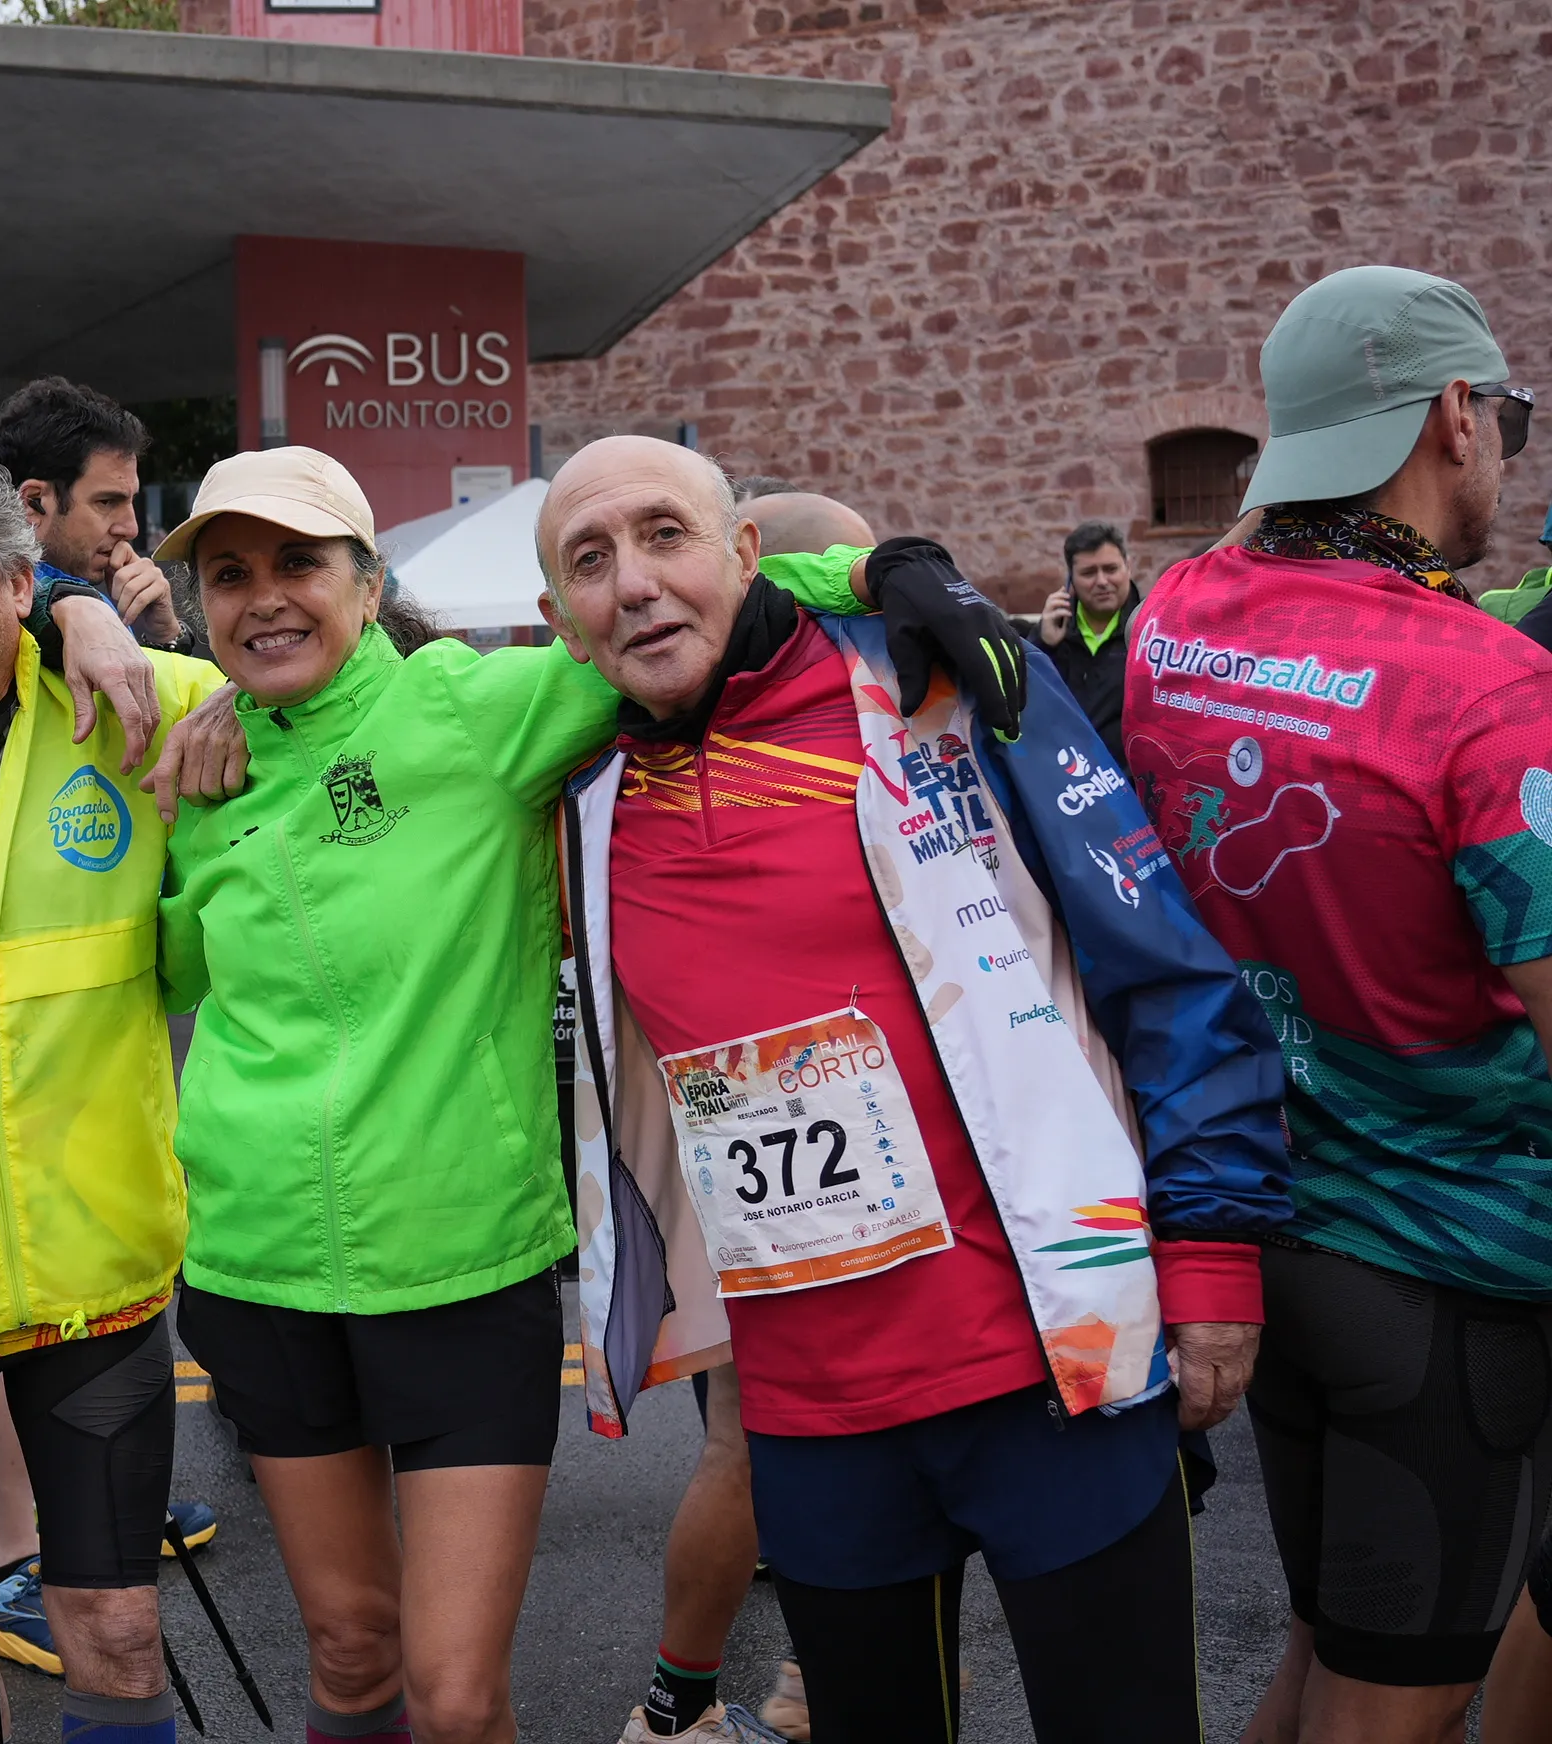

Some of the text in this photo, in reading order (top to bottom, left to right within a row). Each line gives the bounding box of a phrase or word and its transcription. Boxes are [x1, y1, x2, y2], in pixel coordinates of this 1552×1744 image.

[387, 331, 511, 387] BUS
[326, 400, 513, 430] MONTORO
[1148, 637, 1372, 706] quirónsalud
[1154, 687, 1330, 739] La salud persona a persona
[50, 815, 117, 848] Vidas
[807, 1033, 865, 1060] TRAIL
[777, 1044, 885, 1094] CORTO
[686, 1078, 730, 1102] EPORA
[693, 1097, 731, 1118] TRAIL
[737, 1105, 779, 1120] RESULTADOS
[727, 1119, 861, 1204] 372
[741, 1188, 861, 1222] JOSE NOTARIO GARCIA
[871, 1208, 921, 1232] EPORABAD
[839, 1236, 922, 1268] consumicion comida
